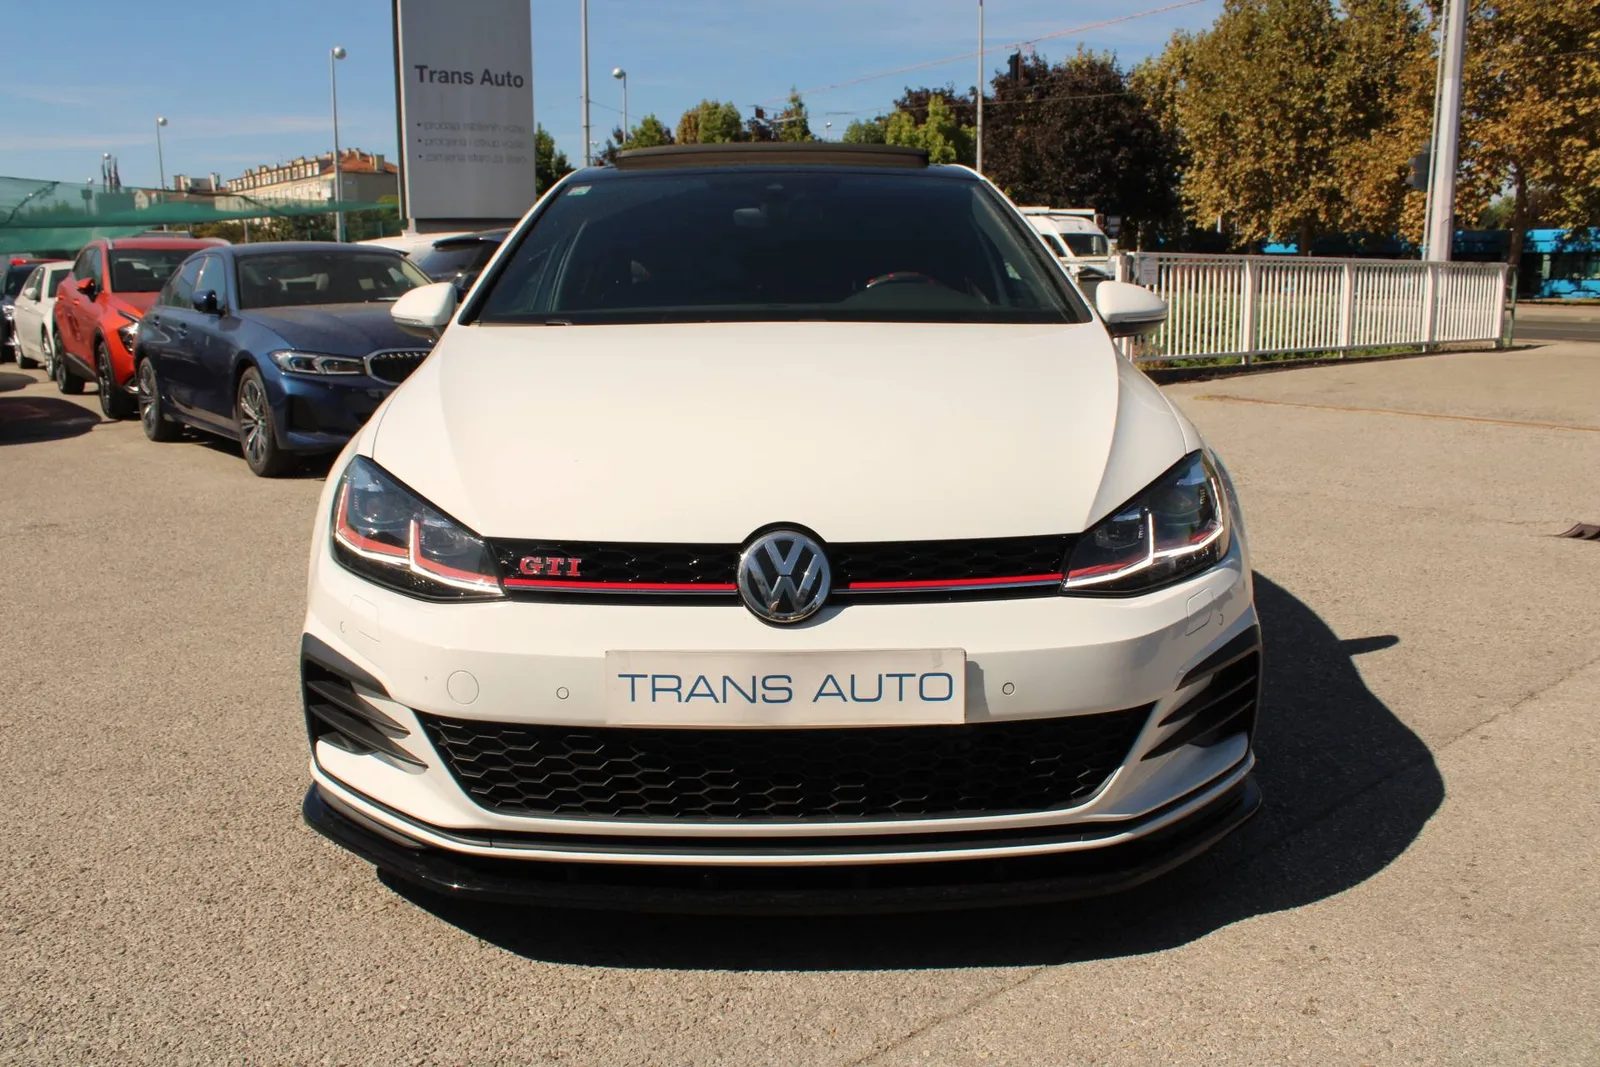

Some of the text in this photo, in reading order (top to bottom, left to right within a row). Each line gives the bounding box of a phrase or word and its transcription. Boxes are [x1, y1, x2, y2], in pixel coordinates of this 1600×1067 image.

[414, 65, 524, 88] Trans Auto
[519, 556, 582, 577] GTI
[617, 672, 954, 704] TRANS AUTO
